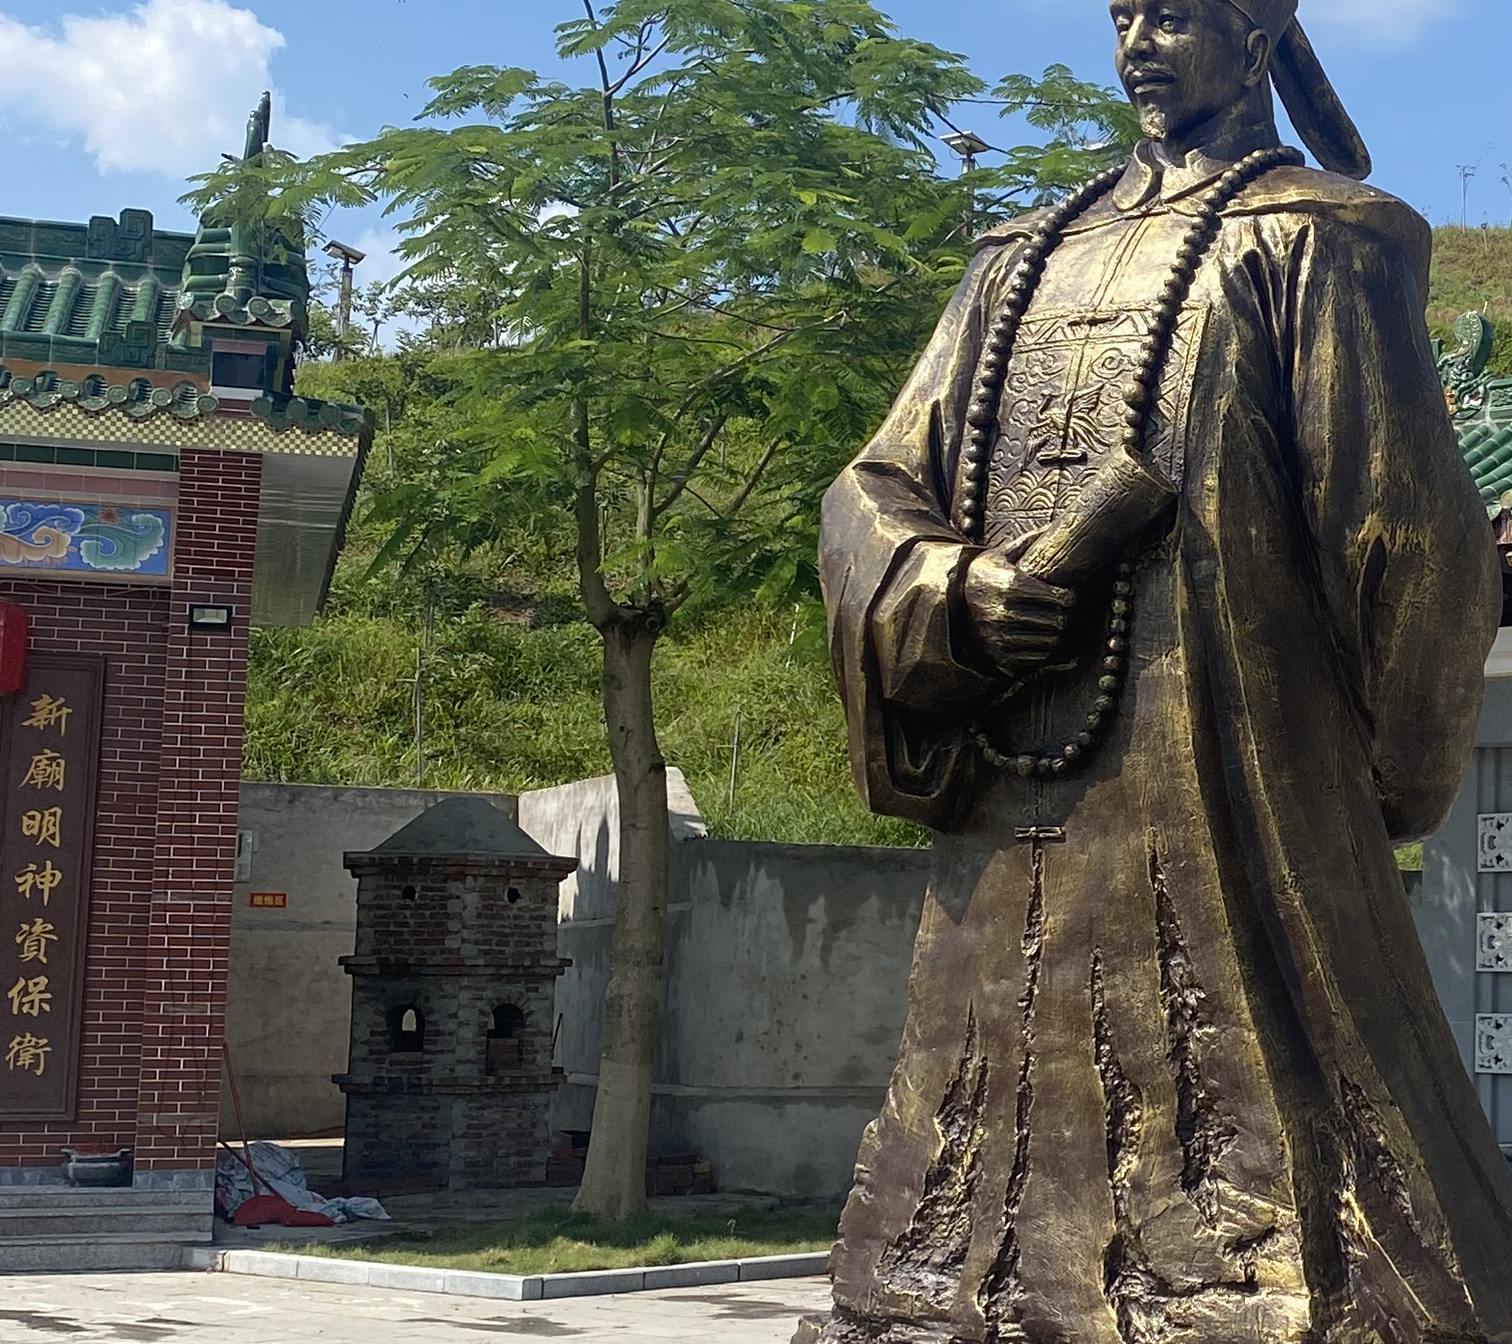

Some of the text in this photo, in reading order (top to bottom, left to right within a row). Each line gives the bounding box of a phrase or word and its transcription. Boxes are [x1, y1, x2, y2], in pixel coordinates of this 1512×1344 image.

[7, 693, 73, 1077] 新廟明神資保衛
